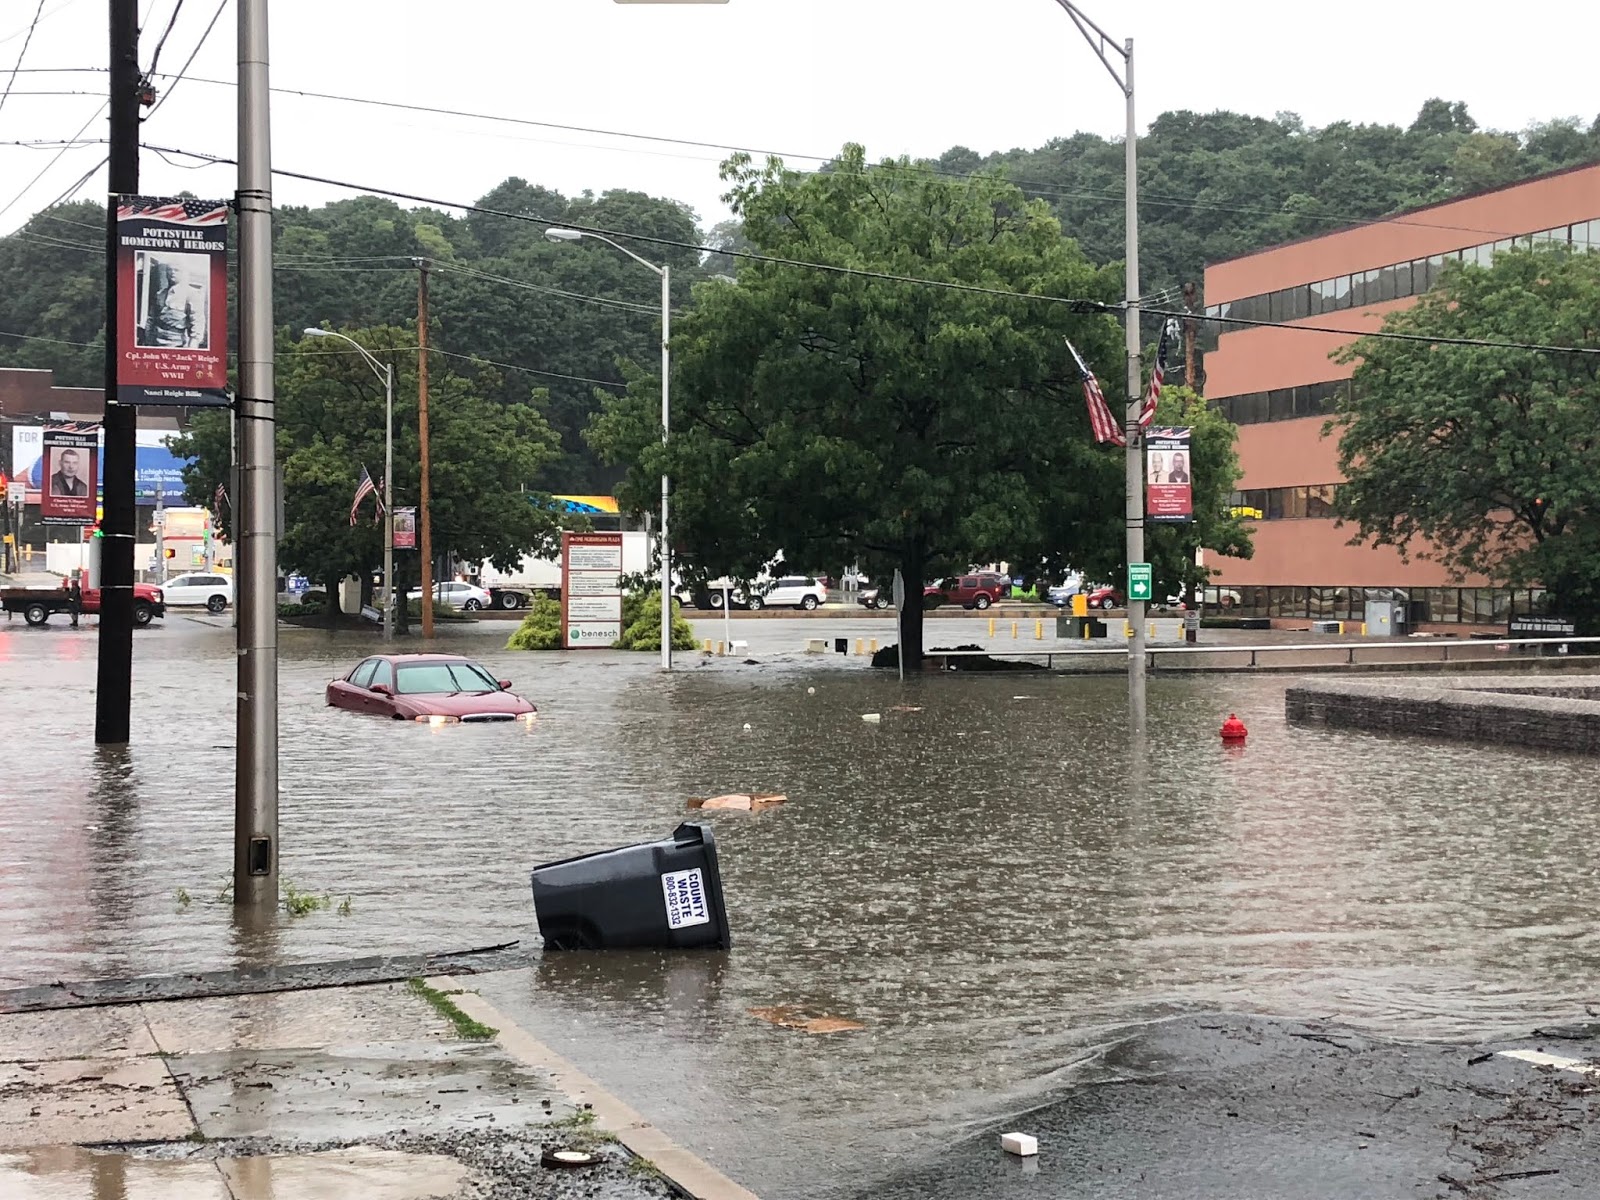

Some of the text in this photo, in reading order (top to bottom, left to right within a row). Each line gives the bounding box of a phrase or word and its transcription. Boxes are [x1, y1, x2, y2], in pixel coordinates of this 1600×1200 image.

[142, 228, 204, 240] POTTSVILLE
[121, 236, 224, 250] HOMETOWN HEROES
[126, 352, 140, 360] Cpl.
[198, 355, 219, 363] Reigle
[19, 432, 38, 442] FOR
[666, 876, 681, 925] 800-832-1332
[678, 878, 692, 918] WASTE
[688, 873, 705, 918] COUNTY
